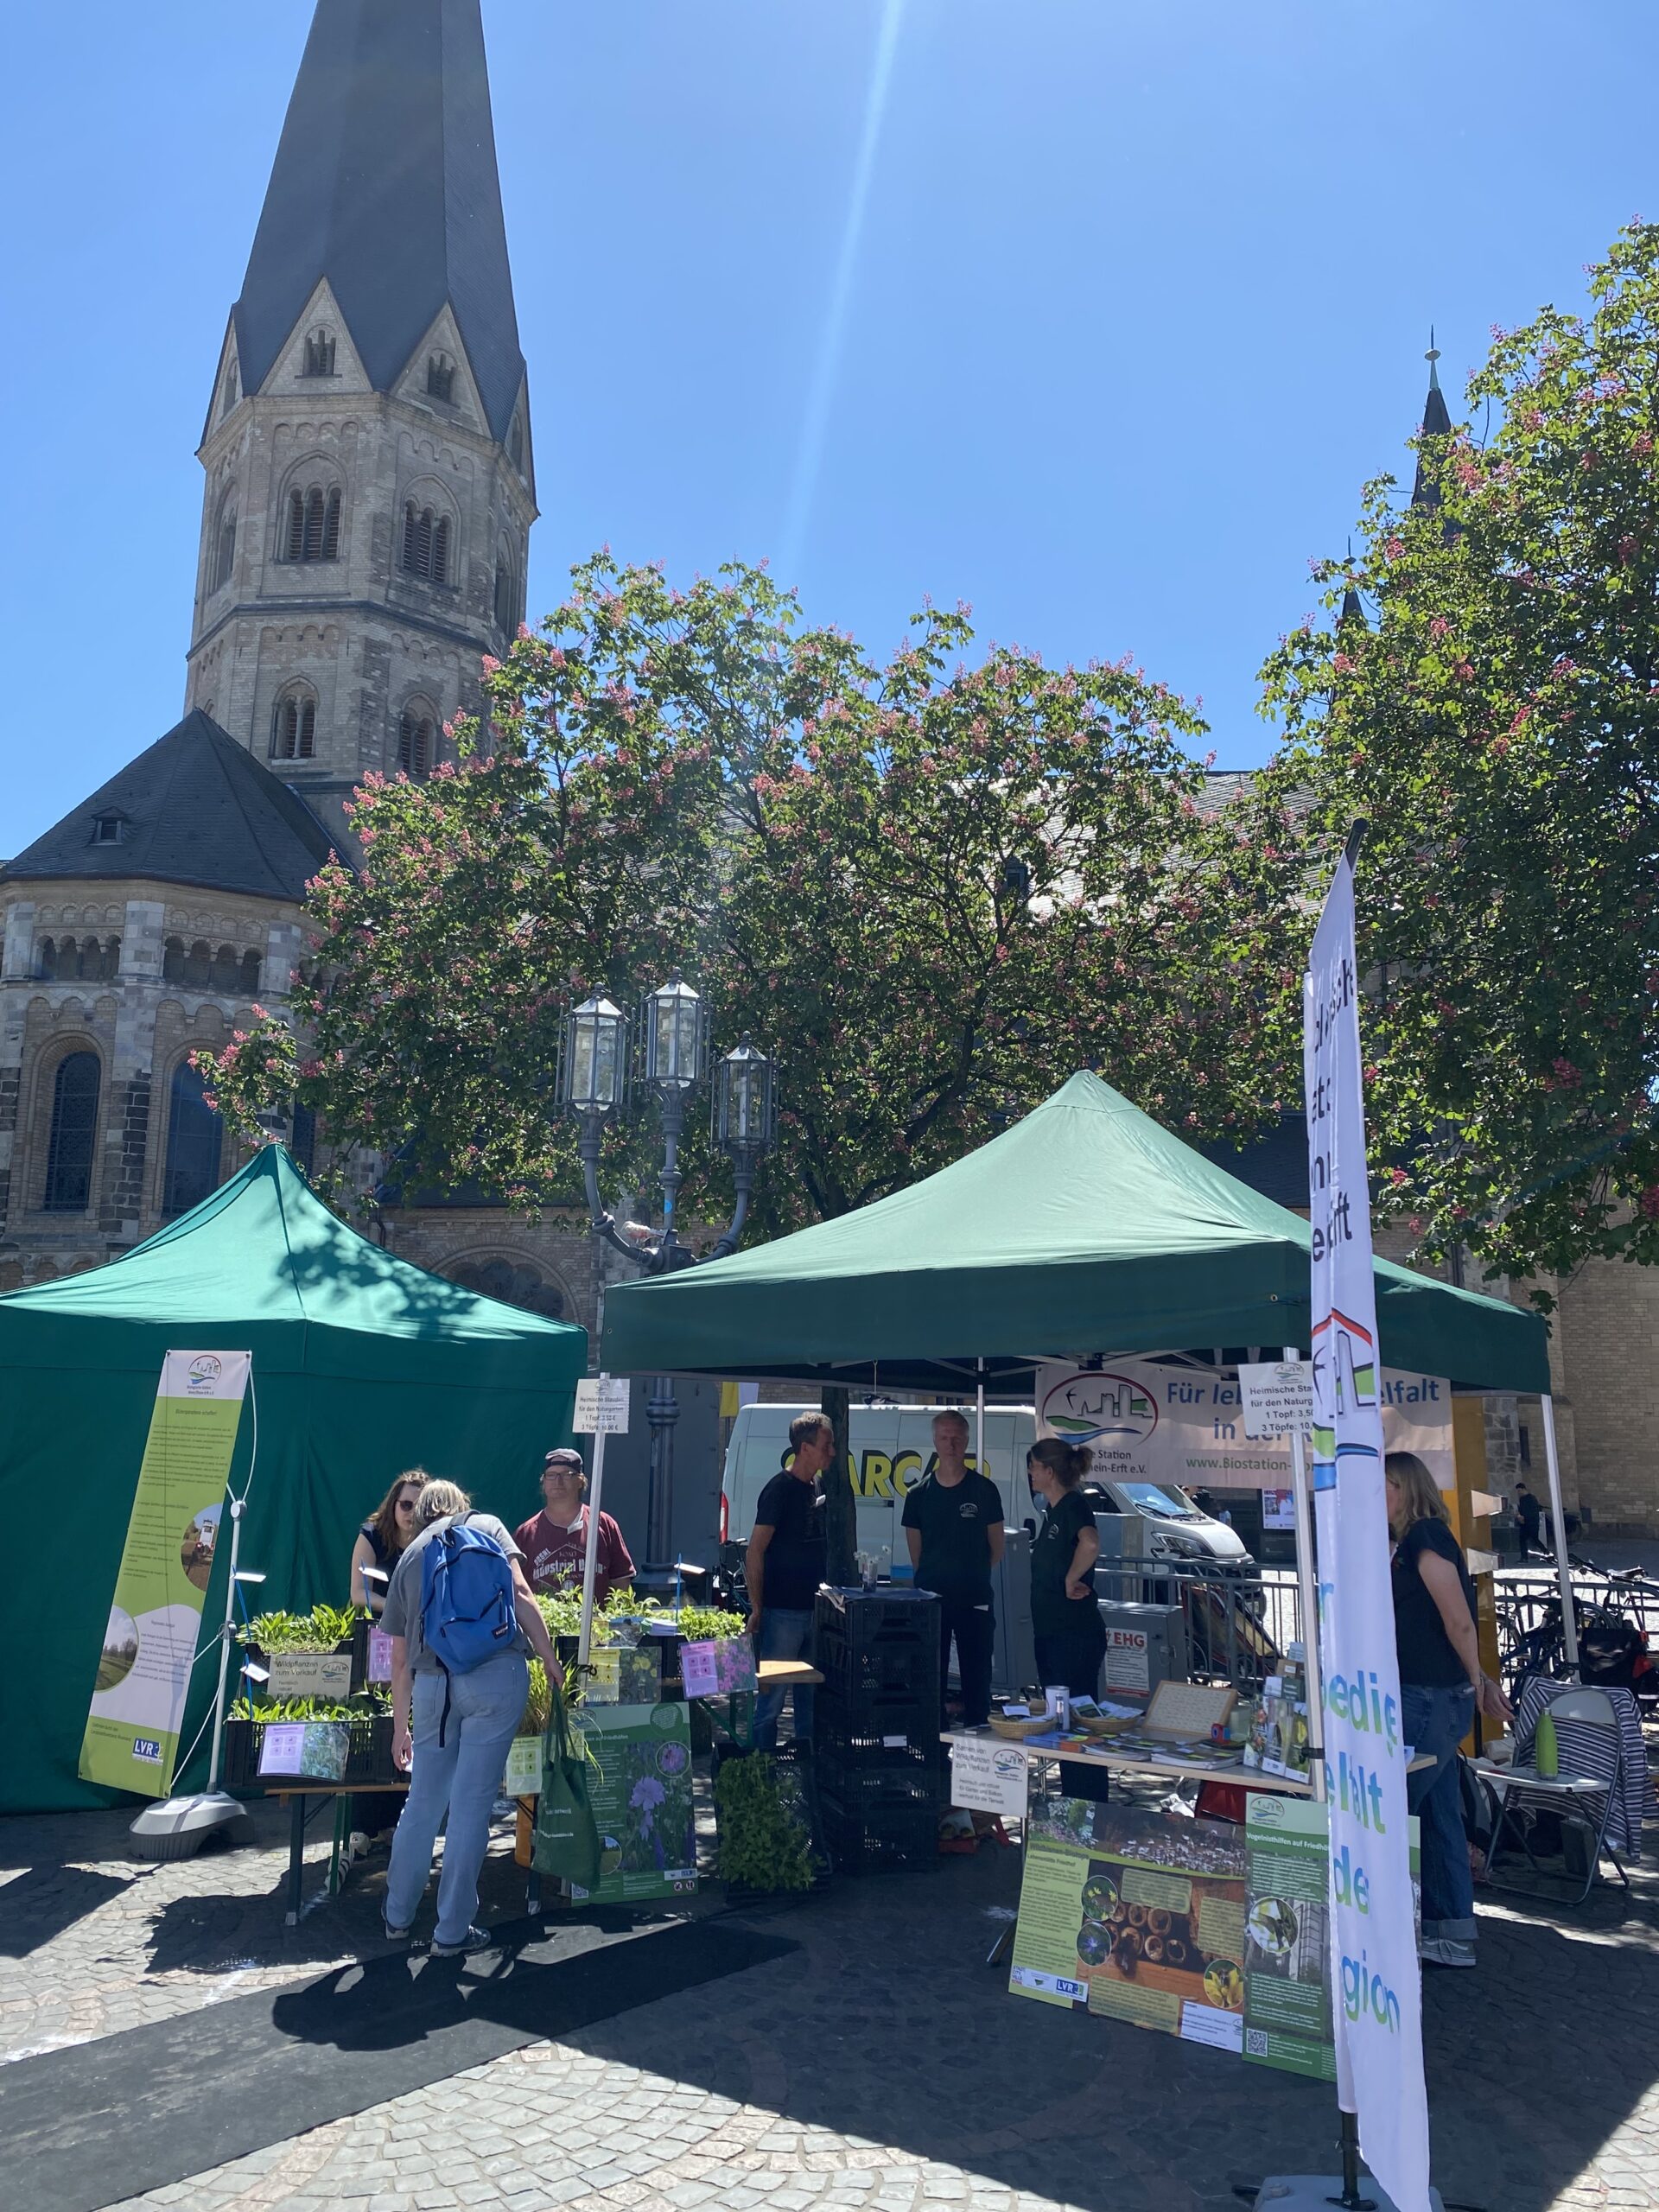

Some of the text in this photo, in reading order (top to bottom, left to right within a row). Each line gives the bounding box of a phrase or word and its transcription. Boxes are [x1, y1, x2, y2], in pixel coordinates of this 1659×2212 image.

[1167, 1382, 1205, 1404] Für
[1249, 1385, 1295, 1395] Heimische
[1265, 1398, 1281, 1407] den
[1273, 1410, 1296, 1420] Topf:
[1214, 1417, 1236, 1440] in
[1269, 1423, 1297, 1433] Töpfe:
[1300, 1422, 1313, 1431] 10,
[1098, 1449, 1131, 1459] Station
[1130, 1464, 1147, 1474] e.V.
[1114, 1631, 1145, 1648] EHG
[276, 1660, 319, 1669] Wildpflanzen
[134, 1739, 155, 1756] LVR
[1246, 1832, 1292, 1846] Vogelnisthilfen
[1304, 1840, 1329, 1851] Friedhö
[1057, 1980, 1073, 1992] LVR
